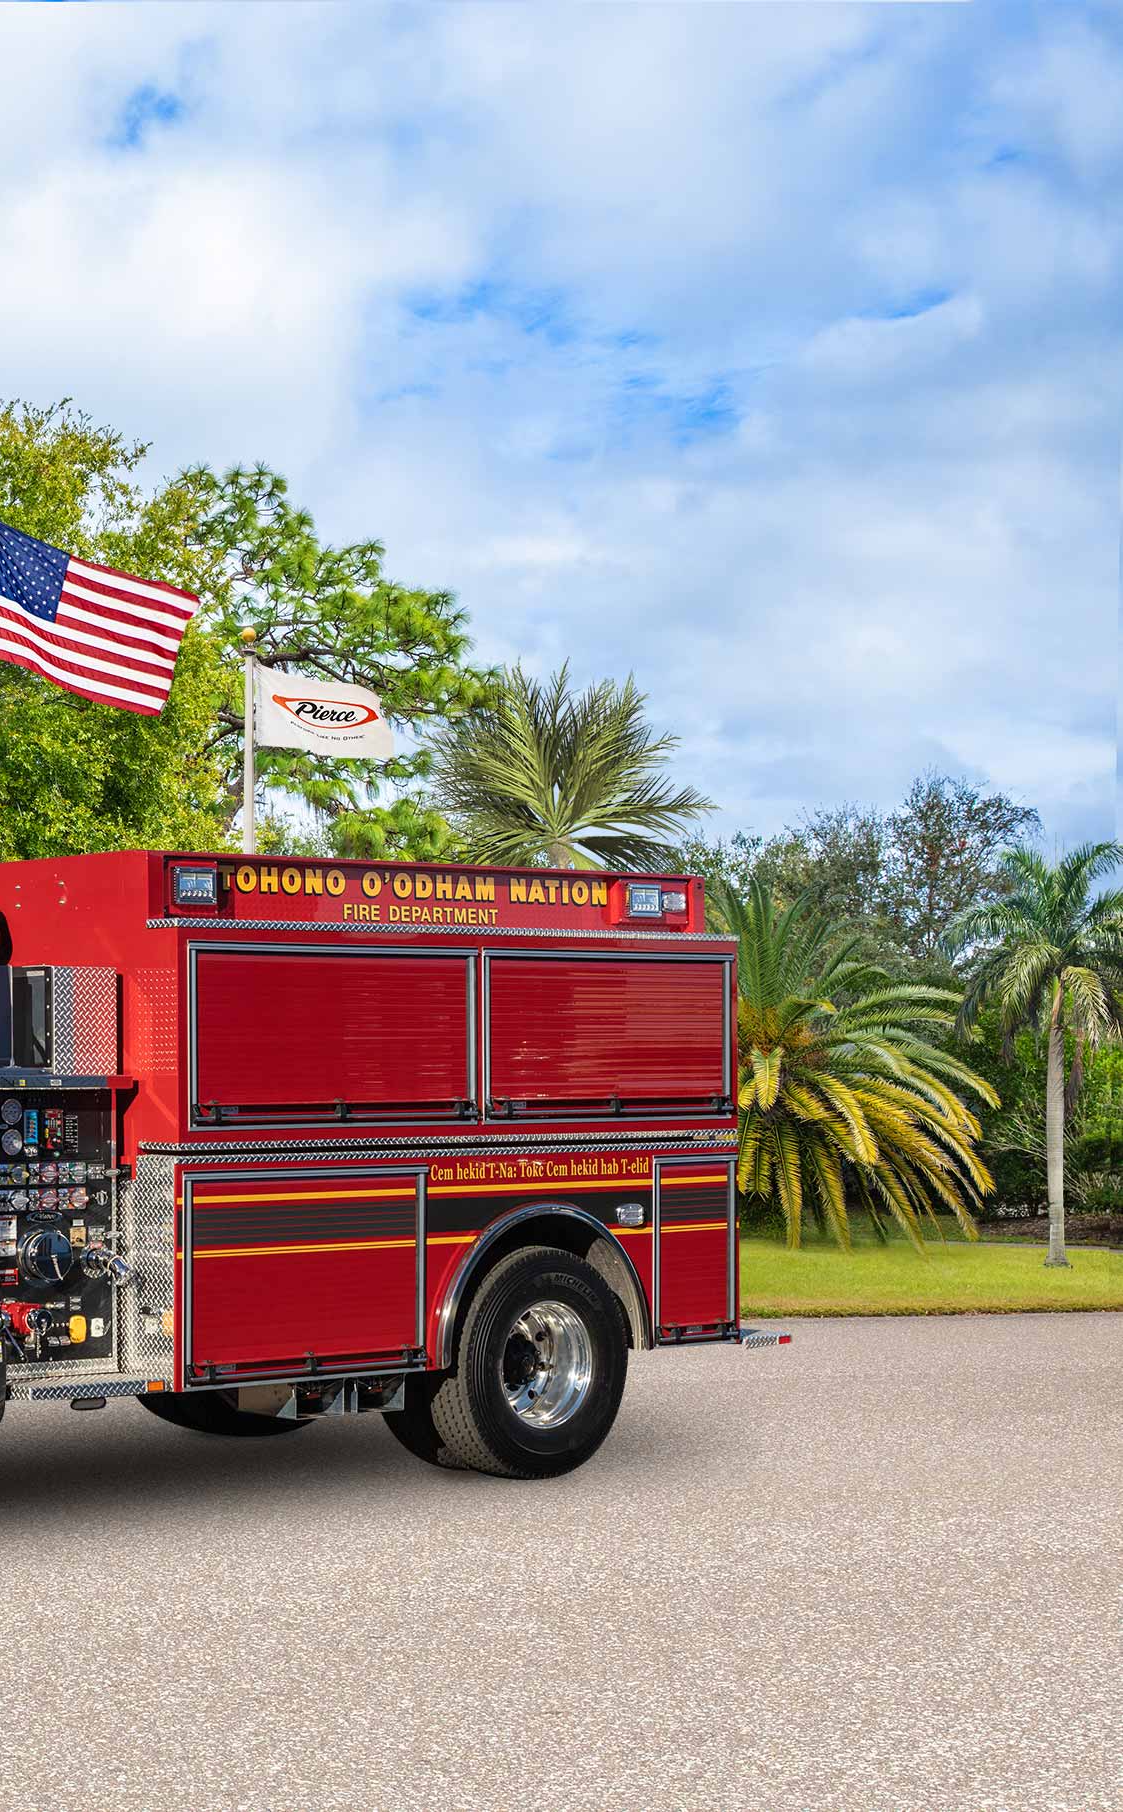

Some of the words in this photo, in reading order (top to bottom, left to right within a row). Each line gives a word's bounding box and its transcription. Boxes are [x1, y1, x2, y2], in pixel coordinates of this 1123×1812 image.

[295, 701, 356, 722] Pierce
[218, 864, 346, 896] TOHONO
[362, 871, 495, 902] O'ODHAM
[510, 877, 608, 906] NATION
[343, 903, 380, 921] FIRE
[389, 905, 499, 925] DEPARTMENT
[430, 1163, 453, 1181] Cem
[457, 1161, 486, 1180] hekid
[546, 1160, 568, 1177] Cem
[570, 1158, 598, 1176] hekid
[600, 1157, 619, 1175] hab
[620, 1156, 649, 1174] T-elid
